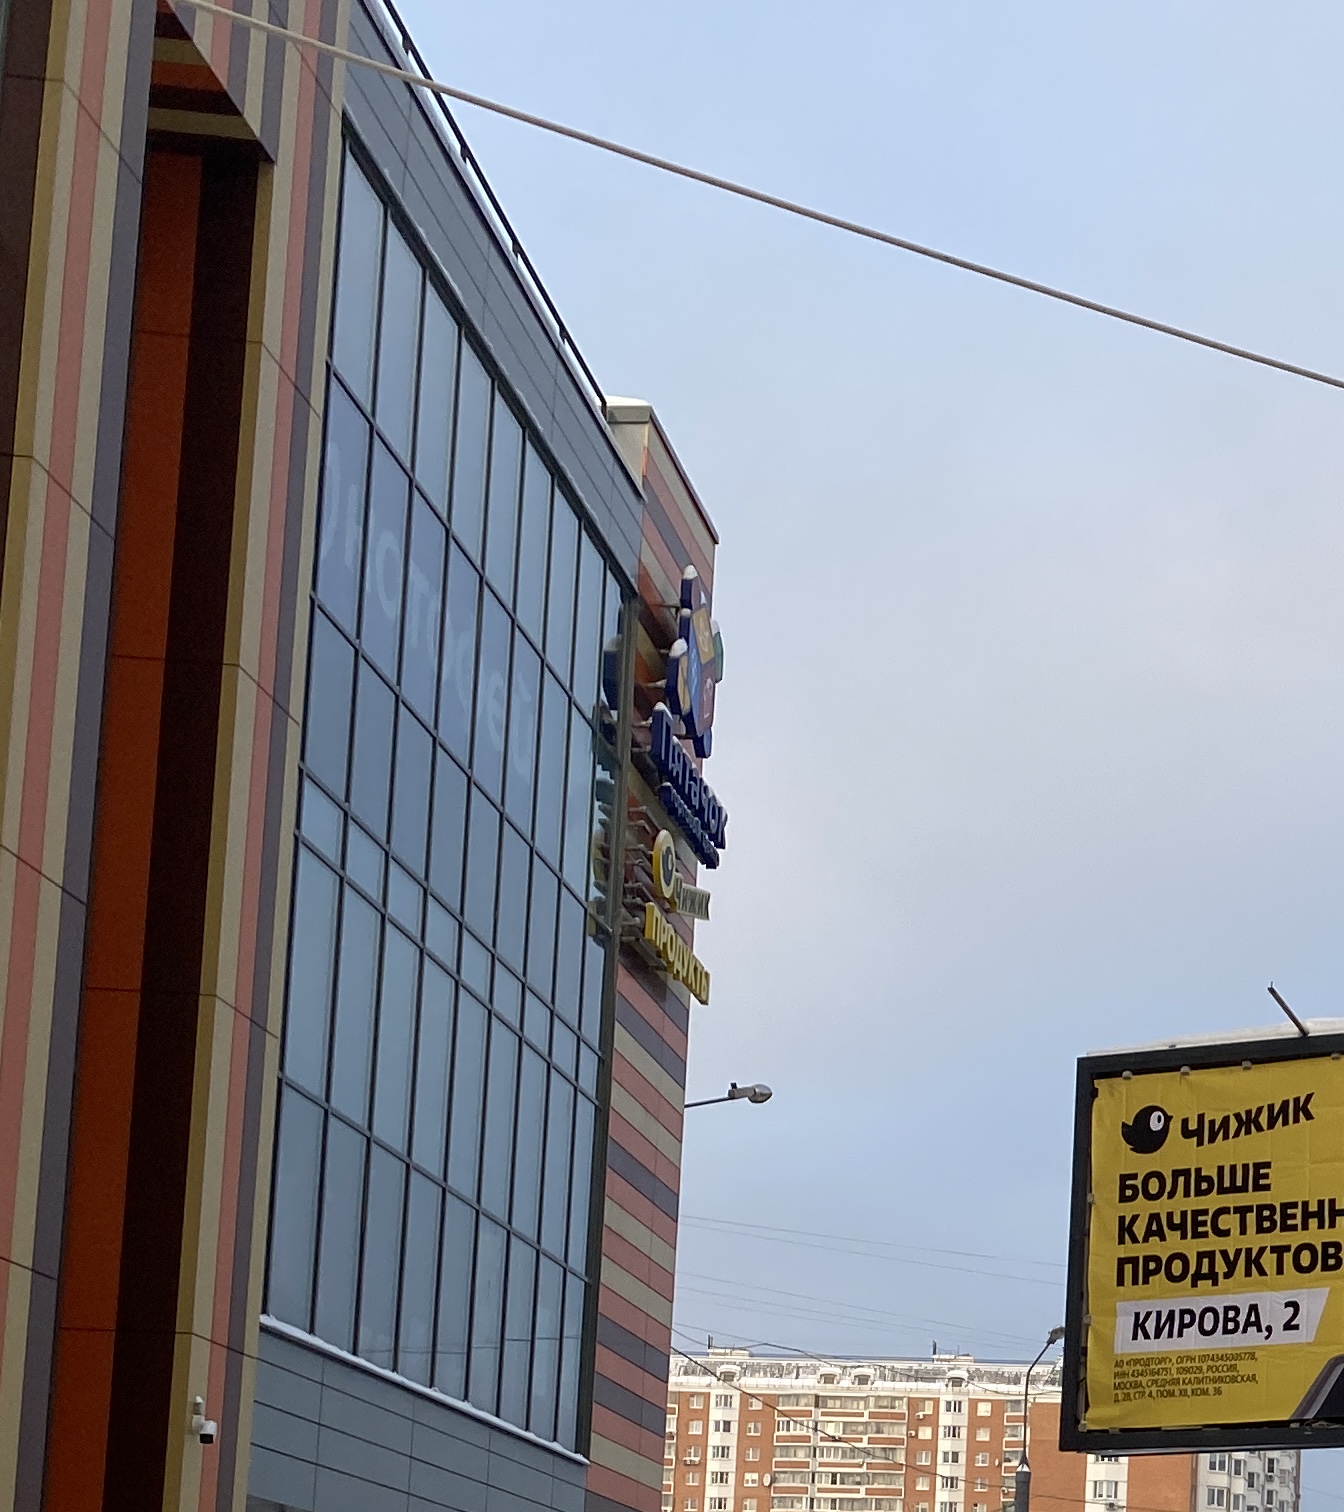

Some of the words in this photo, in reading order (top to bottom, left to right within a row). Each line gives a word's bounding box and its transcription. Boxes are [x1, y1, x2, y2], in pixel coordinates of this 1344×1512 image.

[1118, 1161, 1272, 1203] БОЛЬШЕ
[1131, 1303, 1273, 1341] КИРОВА,
[1282, 1301, 1300, 1331] 2
[1114, 1359, 1124, 1368] АО
[1175, 1355, 1196, 1364] ОГРН
[1114, 1371, 1129, 1380] ИНН
[1206, 1363, 1240, 1374] РОССИЯ,
[1113, 1381, 1145, 1391] МОСКВА,
[1146, 1377, 1181, 1389] СРЕДНЯЯ
[1156, 1388, 1177, 1399] ПОМ.
[1191, 1386, 1211, 1398] КОМ.
[1213, 1386, 1222, 1397] 36
